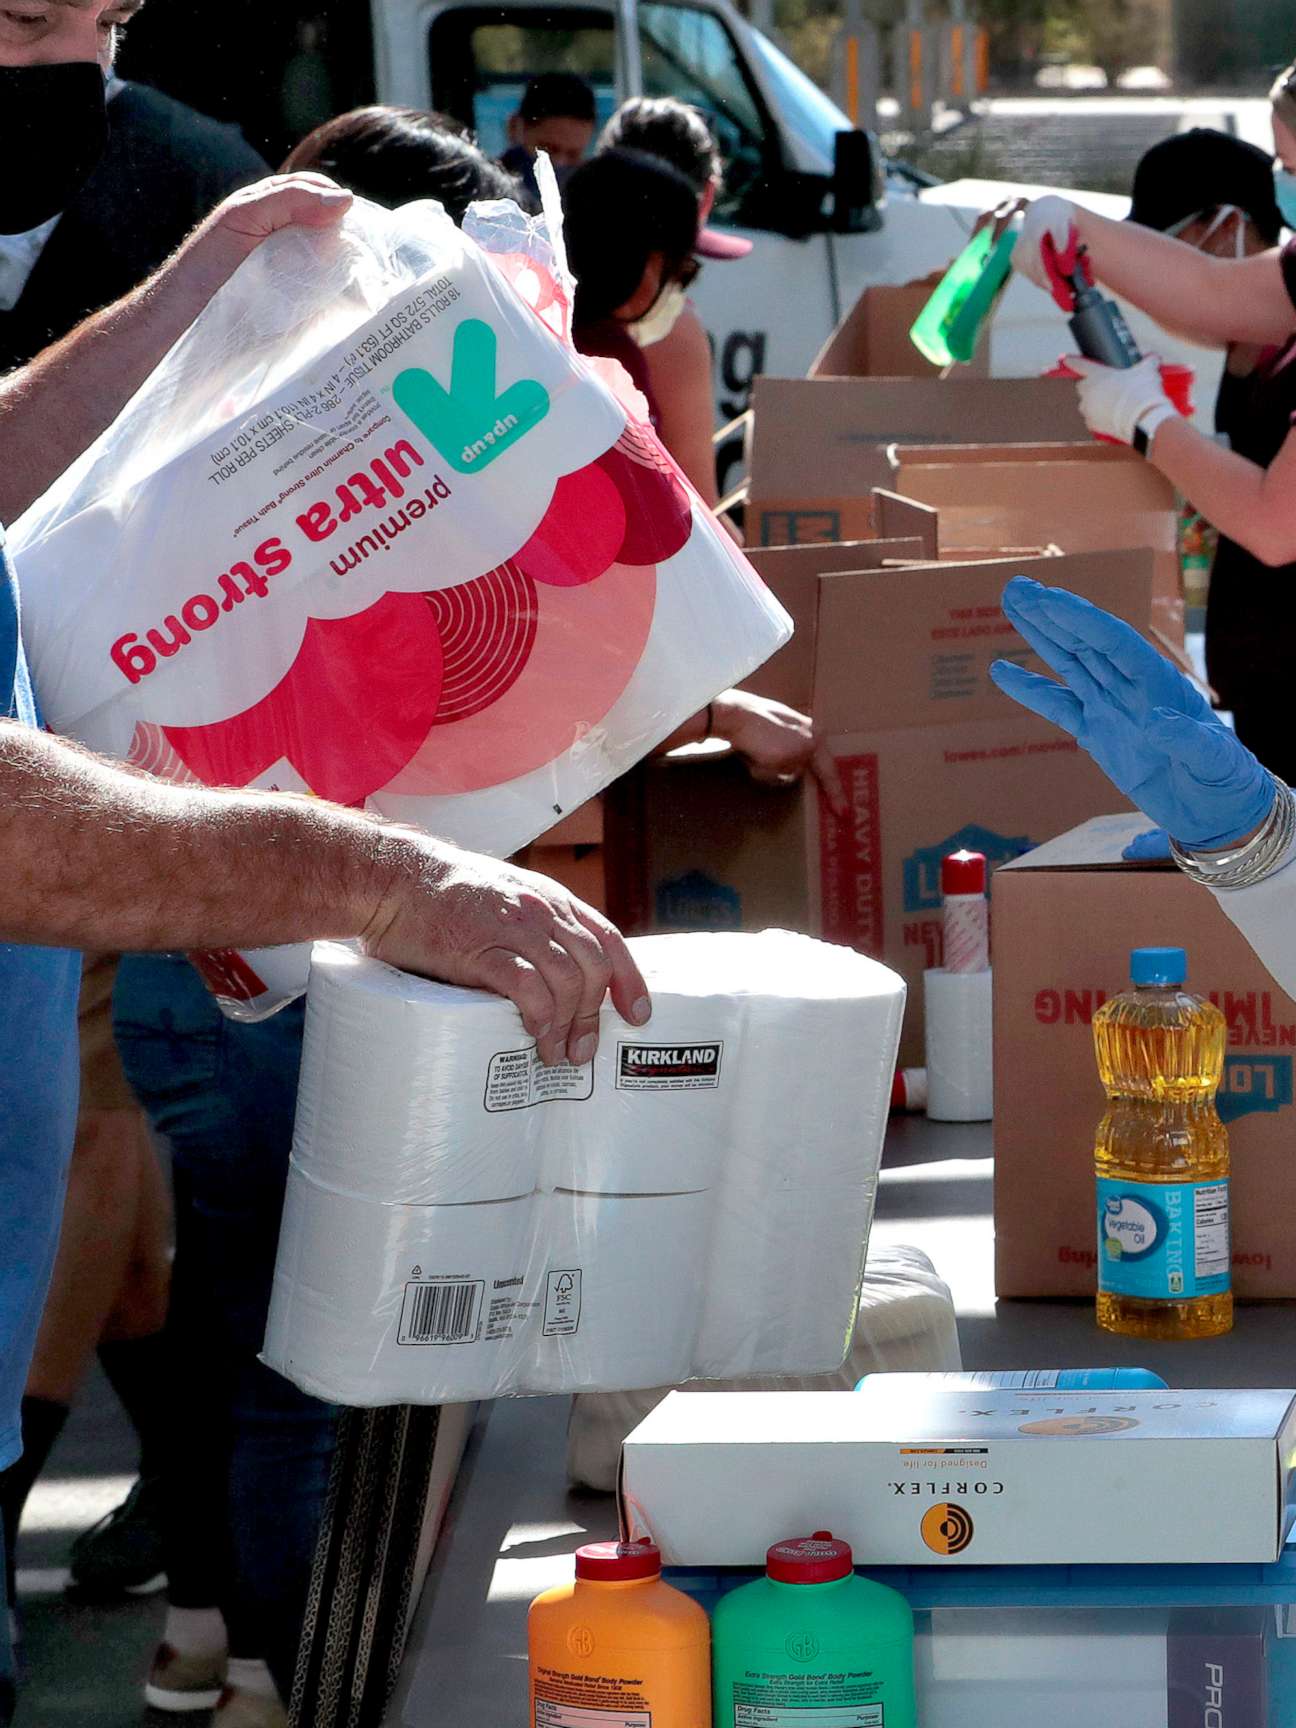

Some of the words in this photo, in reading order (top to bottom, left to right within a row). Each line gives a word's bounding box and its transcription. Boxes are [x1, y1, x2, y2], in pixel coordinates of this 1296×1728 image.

[423, 277, 453, 299] TOTAL
[405, 296, 426, 316] 572
[416, 296, 451, 323] ROLLS
[390, 312, 407, 328] SQ
[378, 324, 393, 340] FT
[365, 319, 422, 366] BATHROOM
[320, 394, 341, 411] 286
[257, 416, 273, 429] cm
[230, 433, 251, 451] 10.1
[255, 420, 294, 452] SHEETS
[456, 410, 520, 465] up&up
[211, 447, 230, 466] cm)
[235, 447, 257, 466] PER
[323, 443, 354, 466] Charmin
[208, 462, 237, 484] ROLL
[305, 466, 324, 480] Ultra
[296, 440, 424, 541] ultra
[258, 501, 277, 515] Bath
[330, 475, 451, 575] premium
[109, 536, 294, 684] strong
[853, 768, 871, 862] HEAVY
[628, 1048, 716, 1065] KIRKLAND
[940, 1457, 987, 1469] Designed
[618, 1677, 643, 1687] Powder
[737, 1705, 752, 1715] Drug
[753, 1706, 770, 1715] Facts
